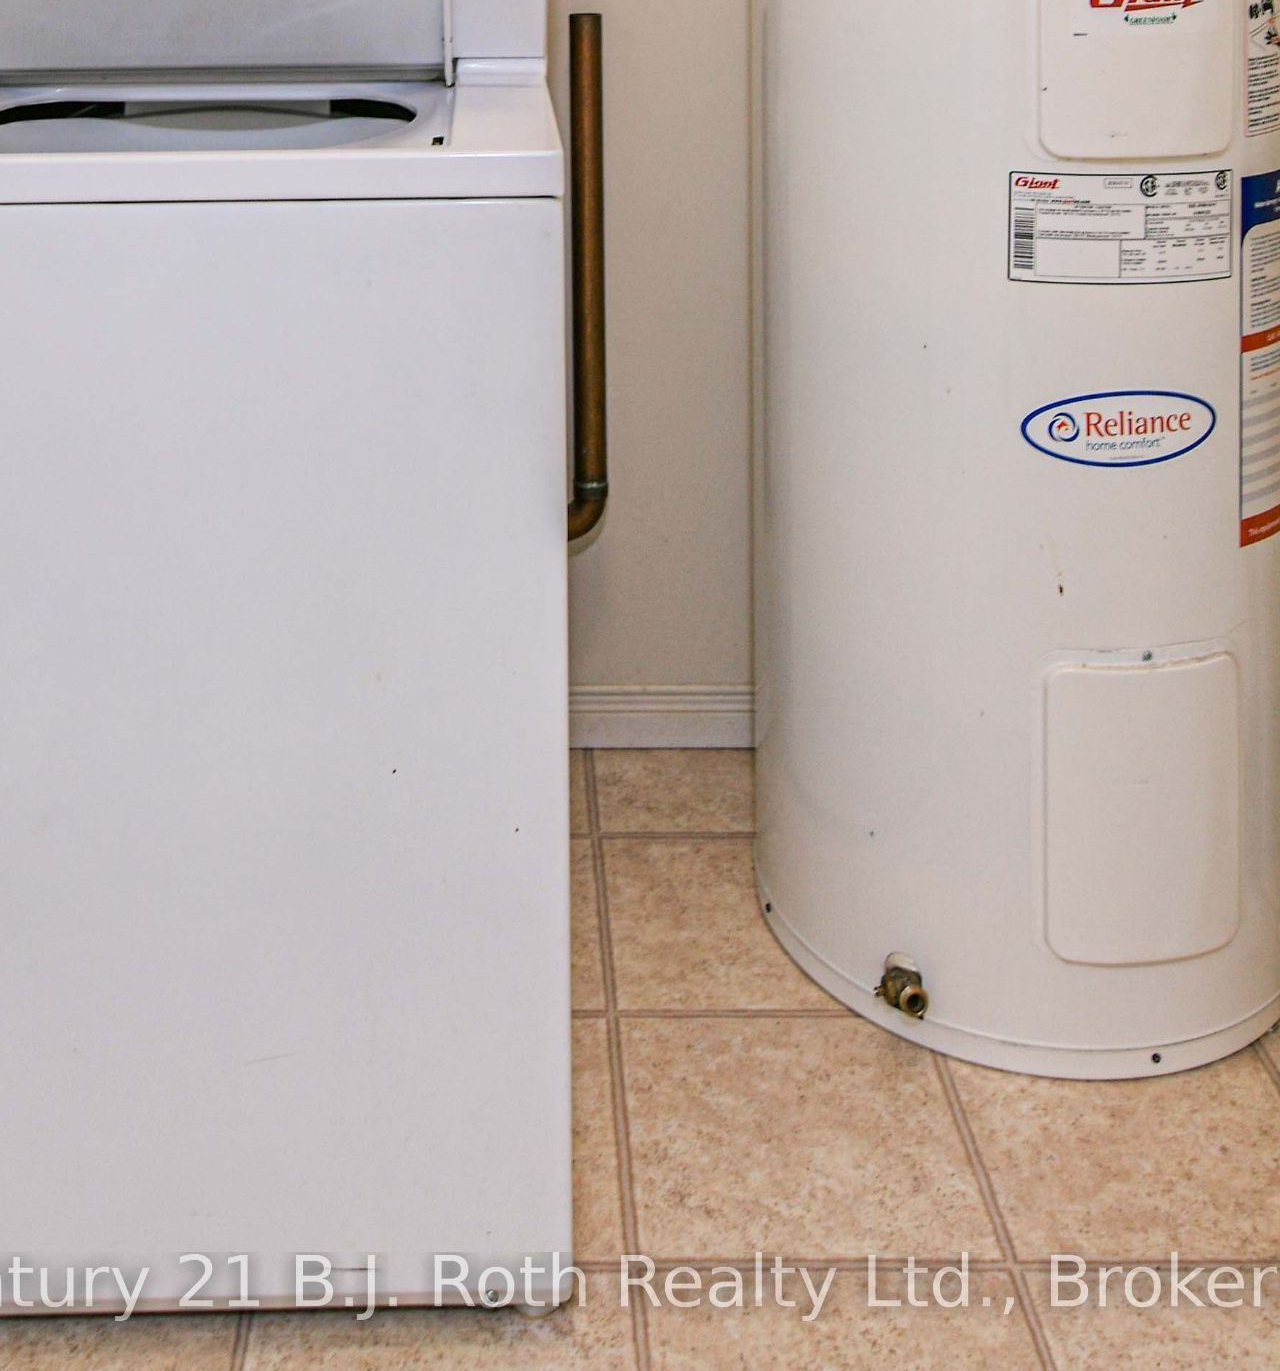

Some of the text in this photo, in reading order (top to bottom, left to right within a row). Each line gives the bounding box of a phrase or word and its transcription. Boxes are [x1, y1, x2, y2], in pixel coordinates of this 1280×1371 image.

[1014, 176, 1060, 190] Giant
[1084, 411, 1192, 437] Reliance
[1086, 439, 1117, 451] home
